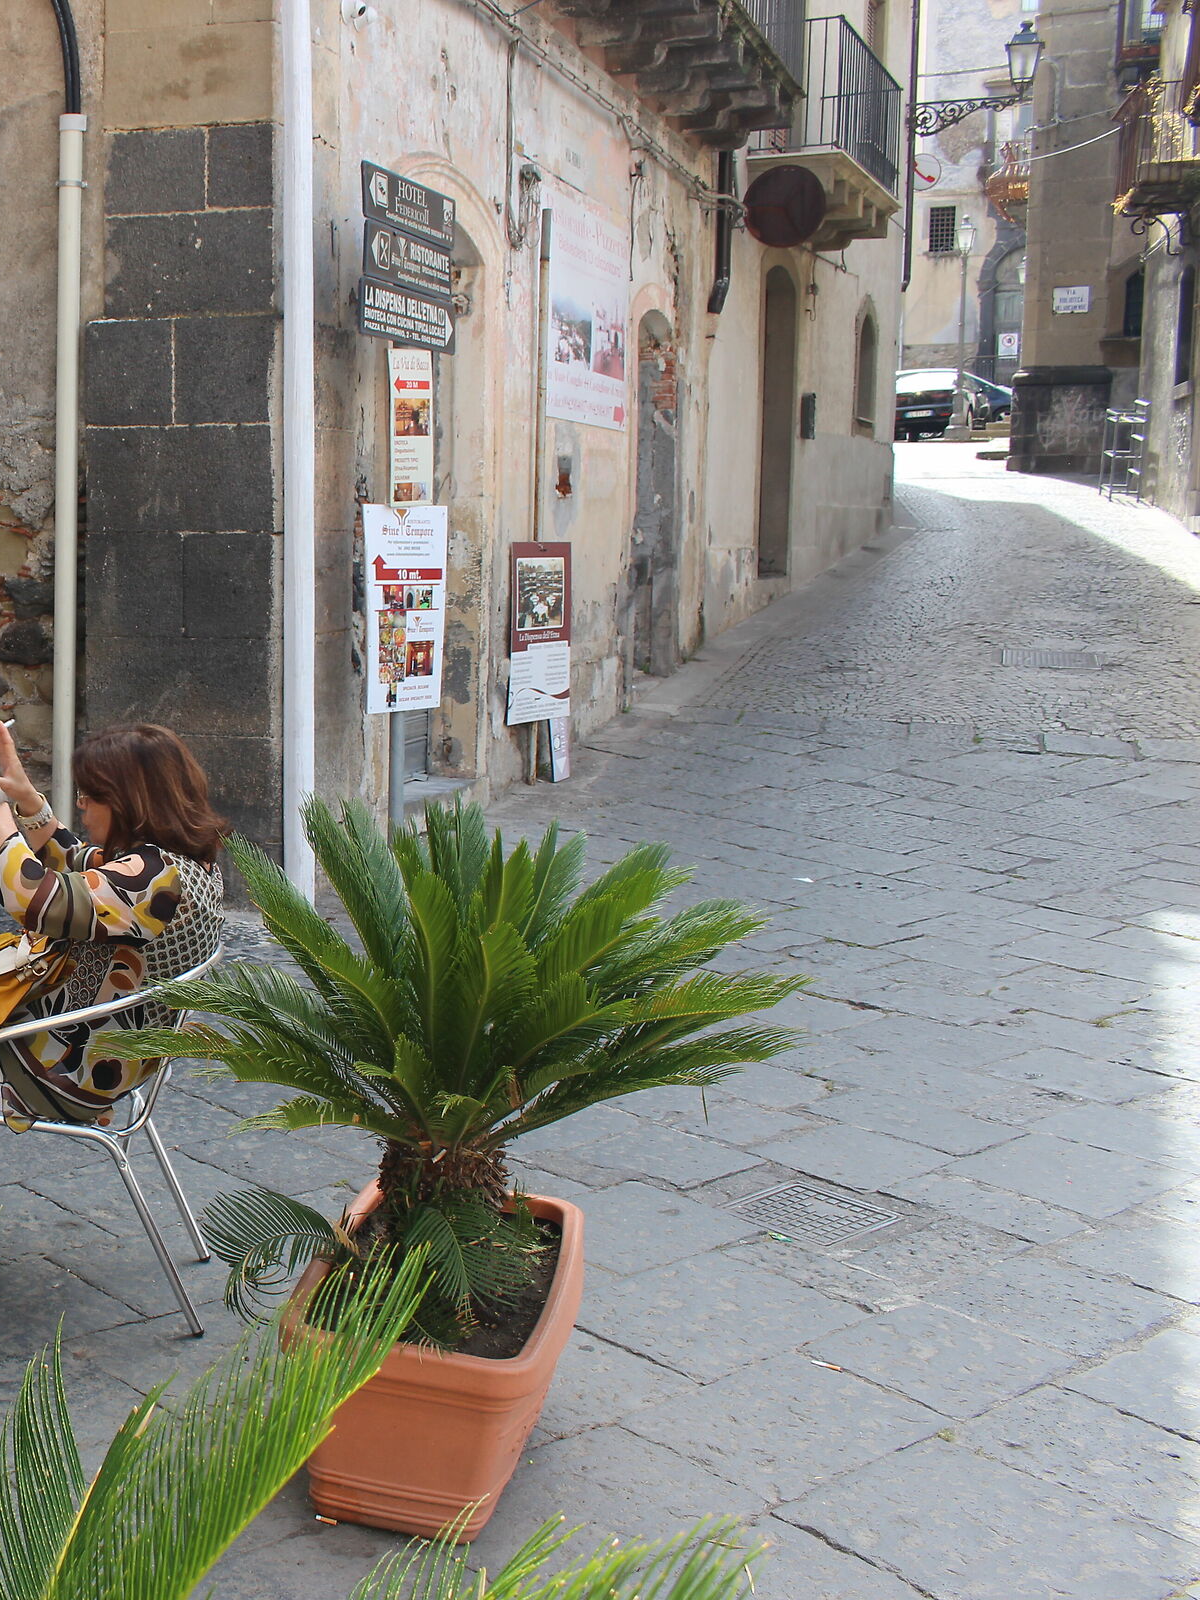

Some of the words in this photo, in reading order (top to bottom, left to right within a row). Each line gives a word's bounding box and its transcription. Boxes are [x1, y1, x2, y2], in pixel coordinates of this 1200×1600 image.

[398, 180, 428, 209] HOTEL
[410, 241, 450, 274] RISTORANTE
[364, 285, 374, 306] LA
[375, 288, 406, 316] DISPENSA
[407, 297, 438, 325] DELL'ETNA
[364, 306, 386, 323] ENOTECA
[387, 312, 397, 326] CON
[397, 315, 414, 331] CUCINA
[414, 320, 429, 334] TIPICA
[429, 324, 445, 338] LOCALE
[364, 320, 380, 331] PIAZZA
[382, 525, 399, 536] Sine
[406, 525, 434, 538] Tempore
[398, 569, 408, 580] 10
[409, 569, 421, 580] mt.
